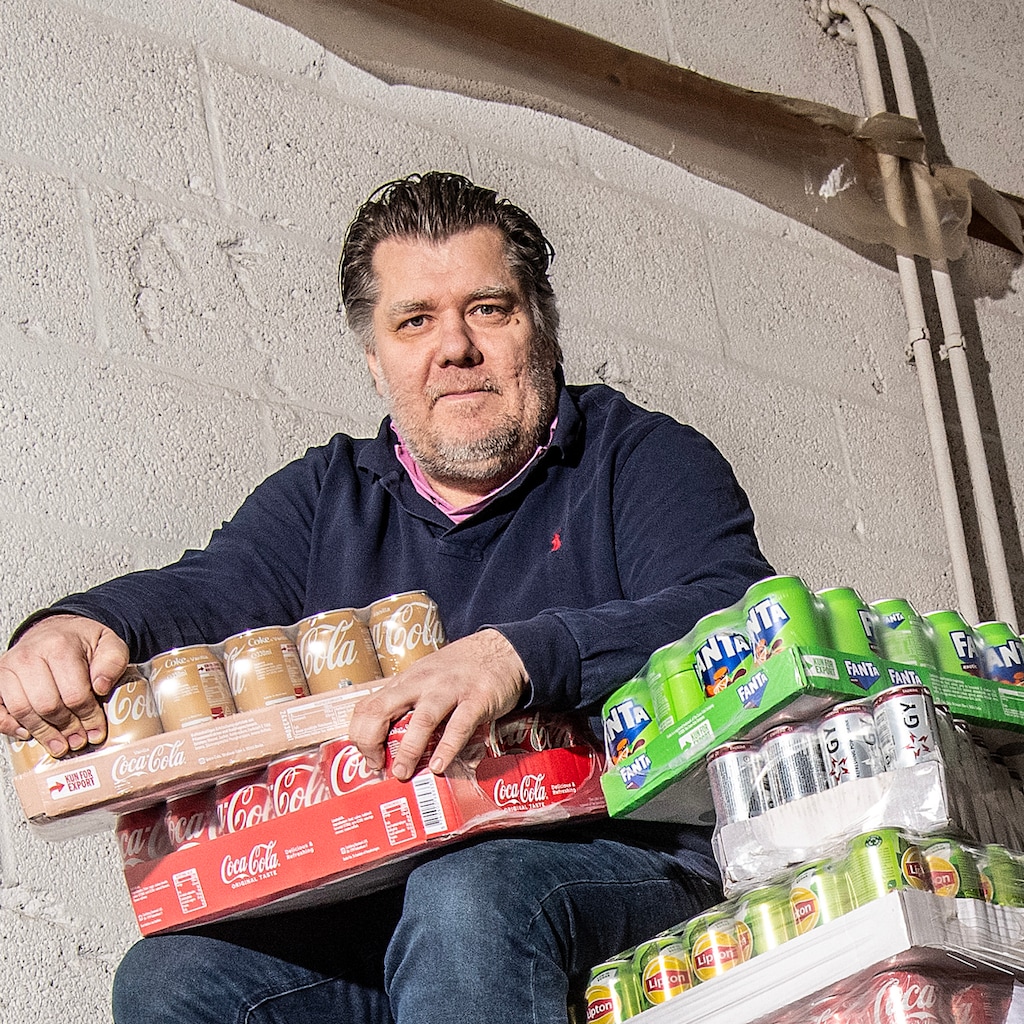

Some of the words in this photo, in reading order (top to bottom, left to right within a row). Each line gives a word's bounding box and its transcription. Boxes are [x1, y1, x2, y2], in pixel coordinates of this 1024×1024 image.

[248, 634, 271, 647] Coke
[165, 657, 185, 669] Coke
[845, 660, 879, 678] FANTA
[737, 671, 769, 702] FANTA
[65, 772, 79, 783] KUN
[80, 769, 93, 780] FOR
[68, 777, 94, 792] EXPORT
[259, 870, 278, 880] TASTE
